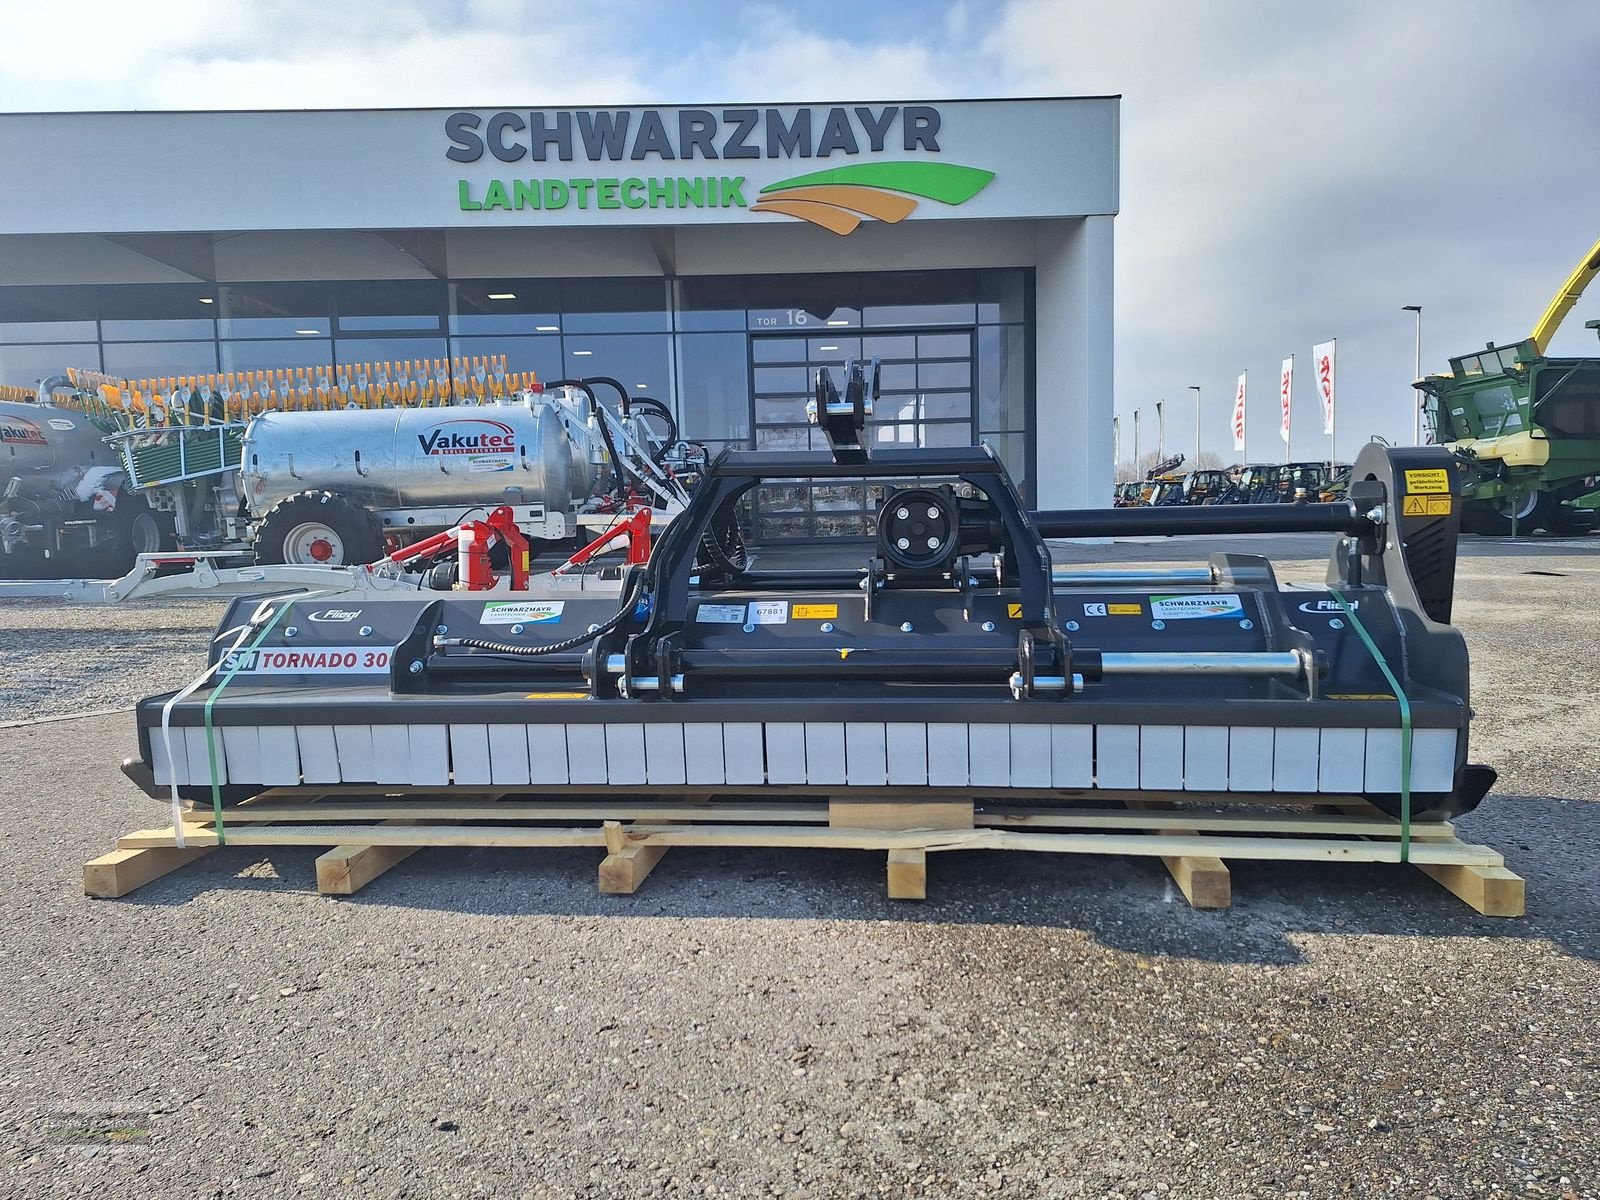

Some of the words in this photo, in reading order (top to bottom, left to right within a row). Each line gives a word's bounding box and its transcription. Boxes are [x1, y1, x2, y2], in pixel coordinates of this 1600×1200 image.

[445, 106, 941, 162] SCHWARZMAYR
[458, 176, 747, 211] LANDTECHNIK
[757, 318, 777, 326] TOR
[786, 309, 807, 325] 16
[417, 429, 515, 455] Vakutec
[322, 609, 363, 621] Fliegl
[1086, 604, 1105, 615] CE
[263, 653, 358, 668] TORNADO
